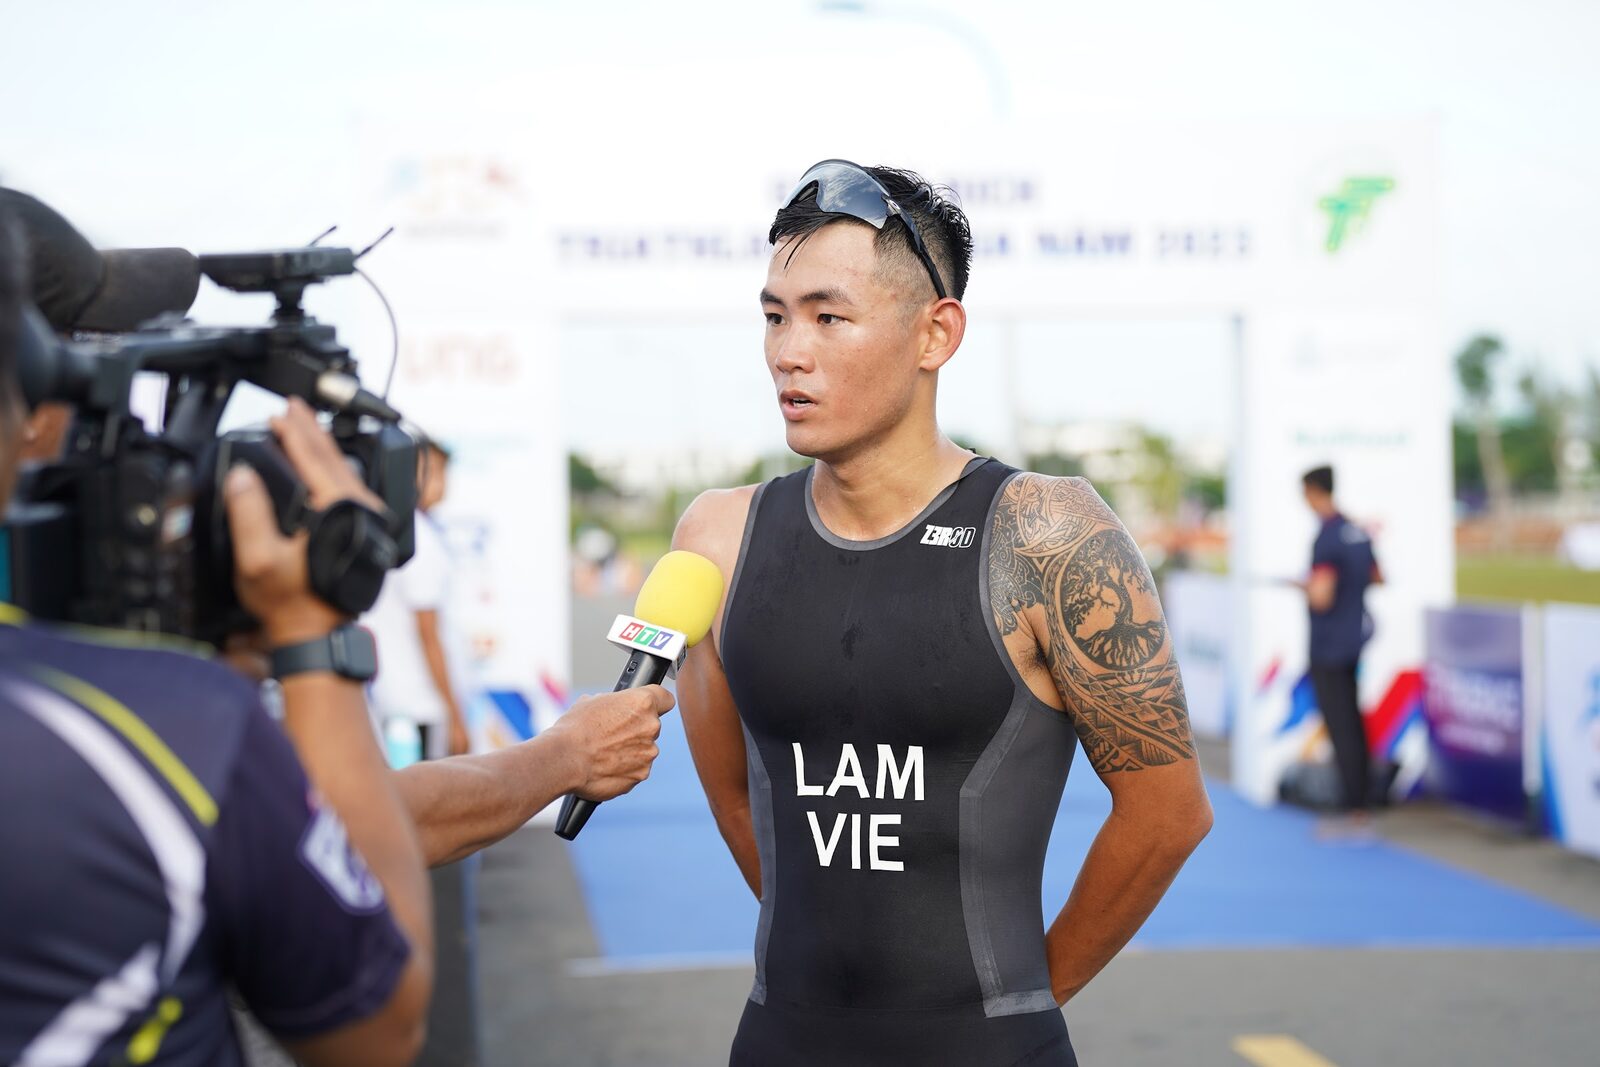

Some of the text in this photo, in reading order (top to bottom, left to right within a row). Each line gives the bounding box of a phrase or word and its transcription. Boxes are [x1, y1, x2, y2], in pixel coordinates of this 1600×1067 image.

[619, 621, 674, 650] HTV
[792, 742, 925, 801] LAM
[806, 811, 905, 872] VIE
